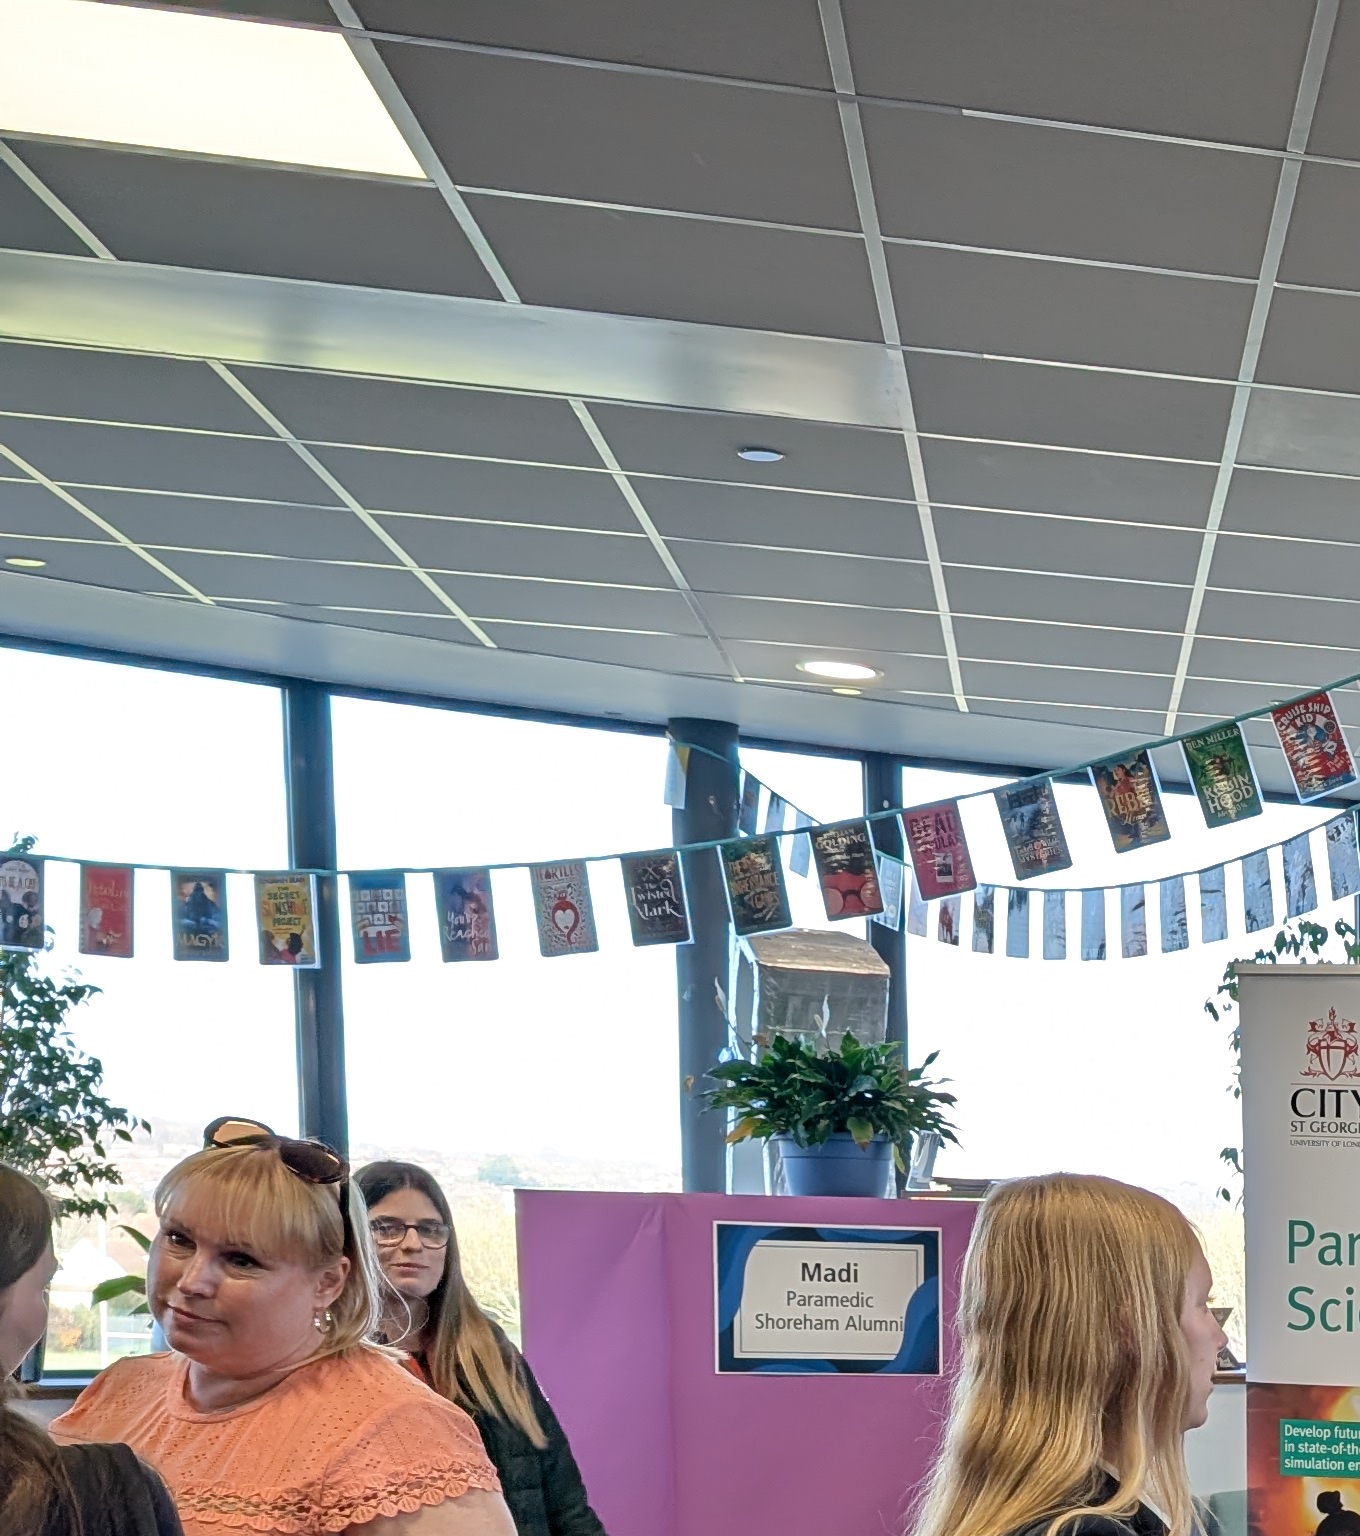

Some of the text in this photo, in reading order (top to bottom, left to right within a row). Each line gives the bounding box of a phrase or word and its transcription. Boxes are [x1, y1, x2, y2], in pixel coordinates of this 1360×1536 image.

[1276, 702, 1332, 732] CRUISE SHIP
[1295, 713, 1315, 728] KID
[1185, 727, 1240, 751] BEN MILLER
[1202, 773, 1250, 800] ROBIN
[1207, 785, 1254, 814] HOOD
[815, 832, 866, 850] GOLDING
[267, 891, 300, 902] SECRET
[271, 916, 302, 928] PROJECT
[363, 929, 401, 956] LIE
[1290, 1120, 1306, 1133] ST
[1290, 1139, 1329, 1147] UNIVERSITY
[800, 1262, 859, 1283] Madi
[786, 1290, 874, 1308] Paramedic
[754, 1312, 904, 1332] Shoreham Alumni
[1284, 1424, 1331, 1441] Develop
[1284, 1441, 1295, 1453] in
[1284, 1457, 1345, 1471] simulation
